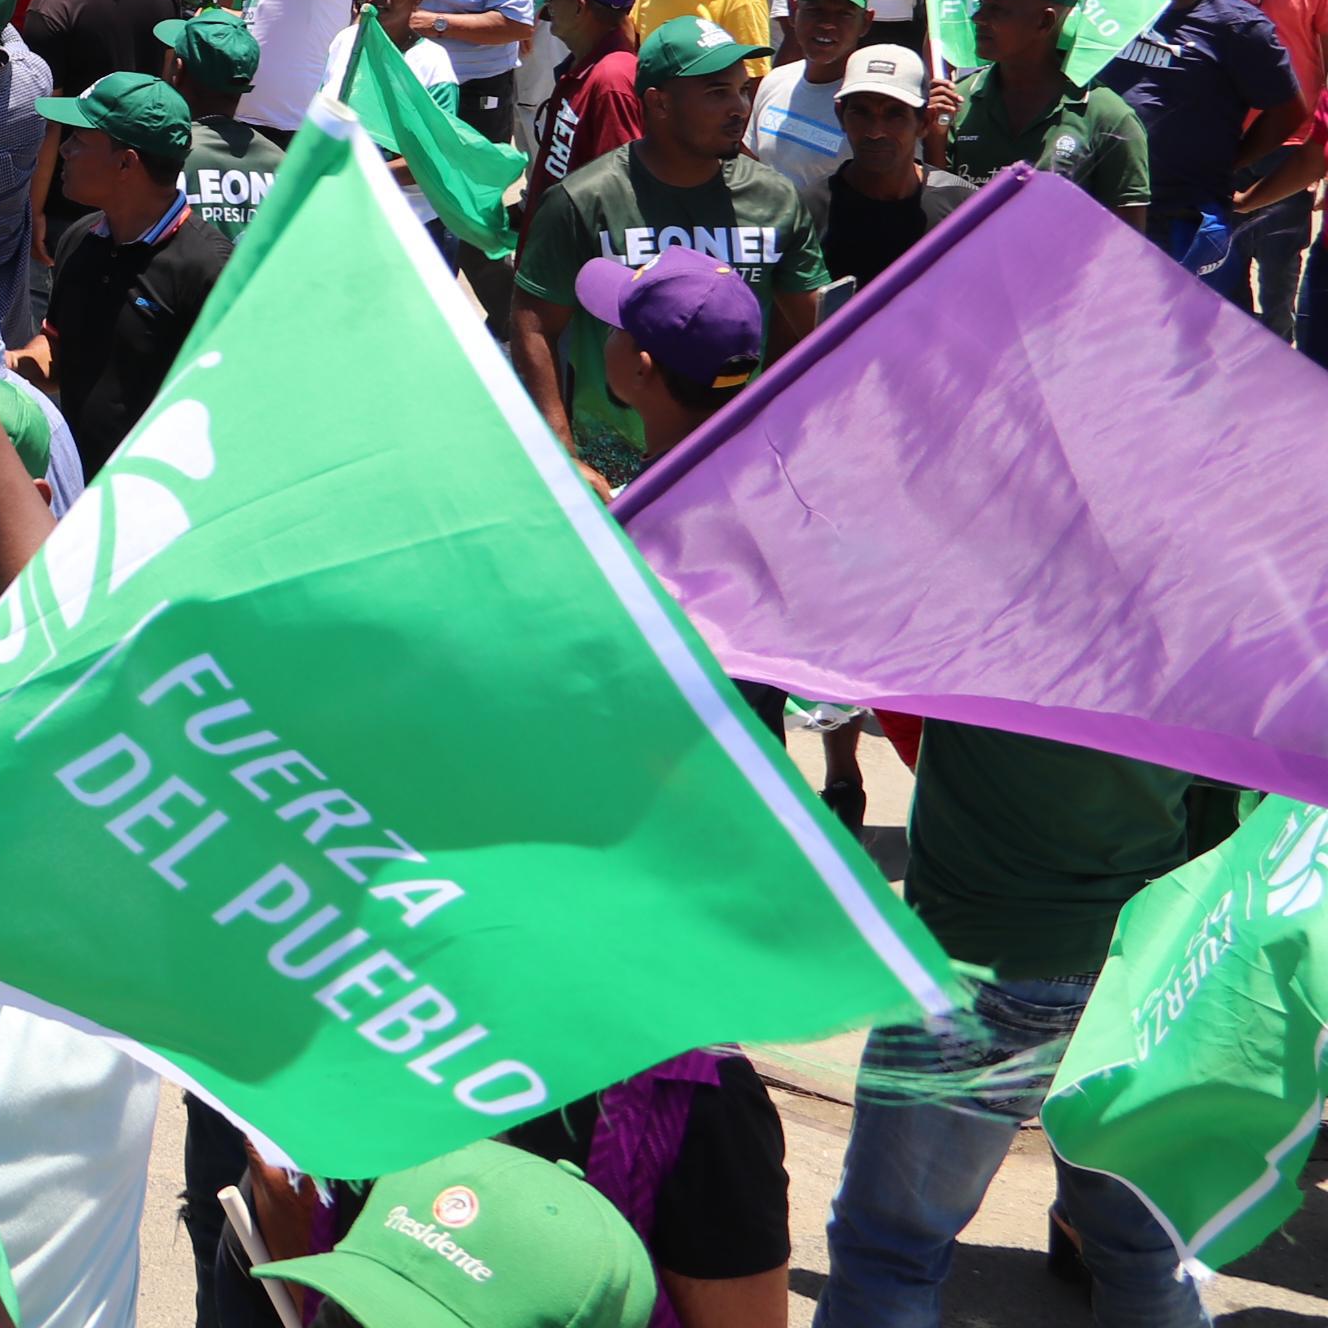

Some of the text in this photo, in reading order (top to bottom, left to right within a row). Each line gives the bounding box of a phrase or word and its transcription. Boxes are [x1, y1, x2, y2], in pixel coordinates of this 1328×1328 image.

[176, 169, 275, 205] LEON
[599, 225, 784, 267] LEONEL
[138, 652, 466, 928] FUERZA
[53, 731, 548, 1116] DEL PUEBLO
[384, 1205, 494, 1282] Presidente
